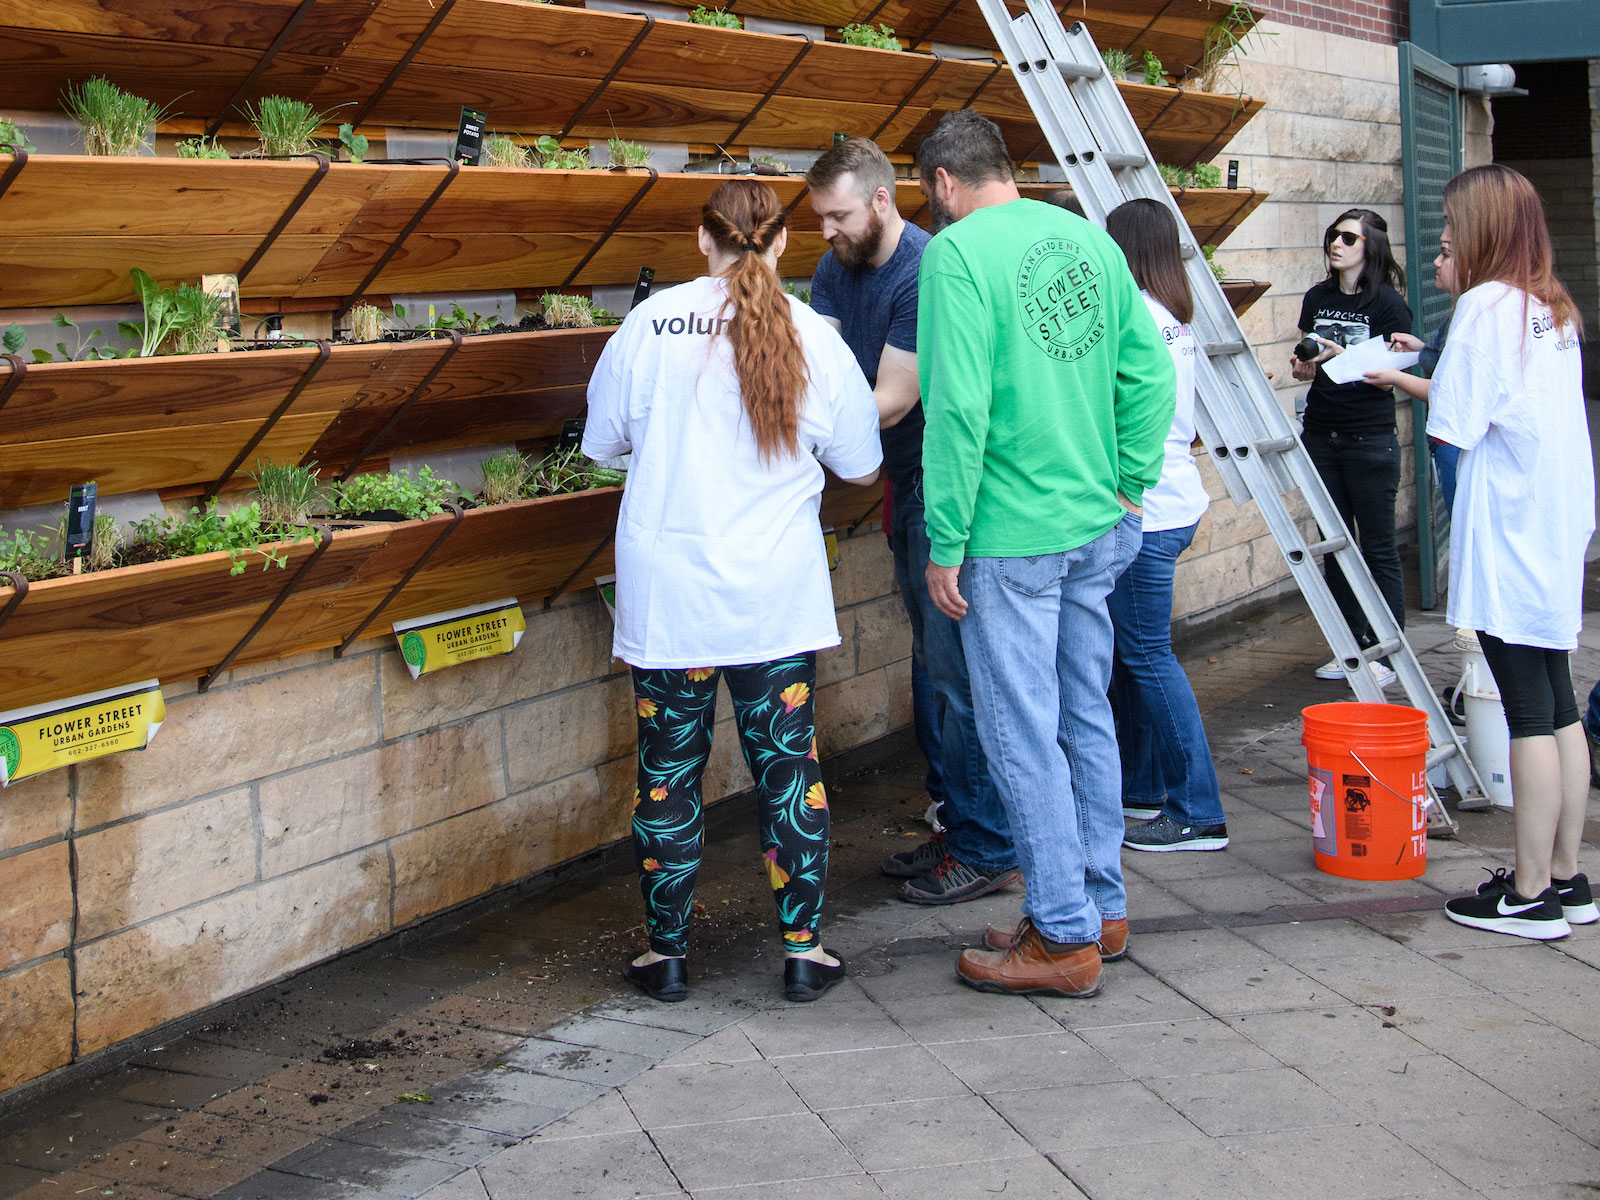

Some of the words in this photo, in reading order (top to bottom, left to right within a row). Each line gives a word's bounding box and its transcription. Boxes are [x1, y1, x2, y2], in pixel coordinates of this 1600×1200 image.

[1019, 255, 1036, 298] URBAN
[1024, 261, 1094, 321] FLOWER
[652, 311, 731, 336] volun
[1039, 283, 1101, 341] STEET
[1313, 308, 1371, 324] HVRCHES
[436, 626, 472, 643] FLOWER
[475, 618, 508, 634] STREET
[446, 638, 468, 649] URBAN
[470, 631, 500, 644] GARDENS
[39, 717, 91, 740] FLOWER
[98, 704, 143, 725] STREET
[53, 732, 85, 747] URBAN
[88, 721, 130, 738] GARDENS
[68, 738, 119, 757] 602-327-6560
